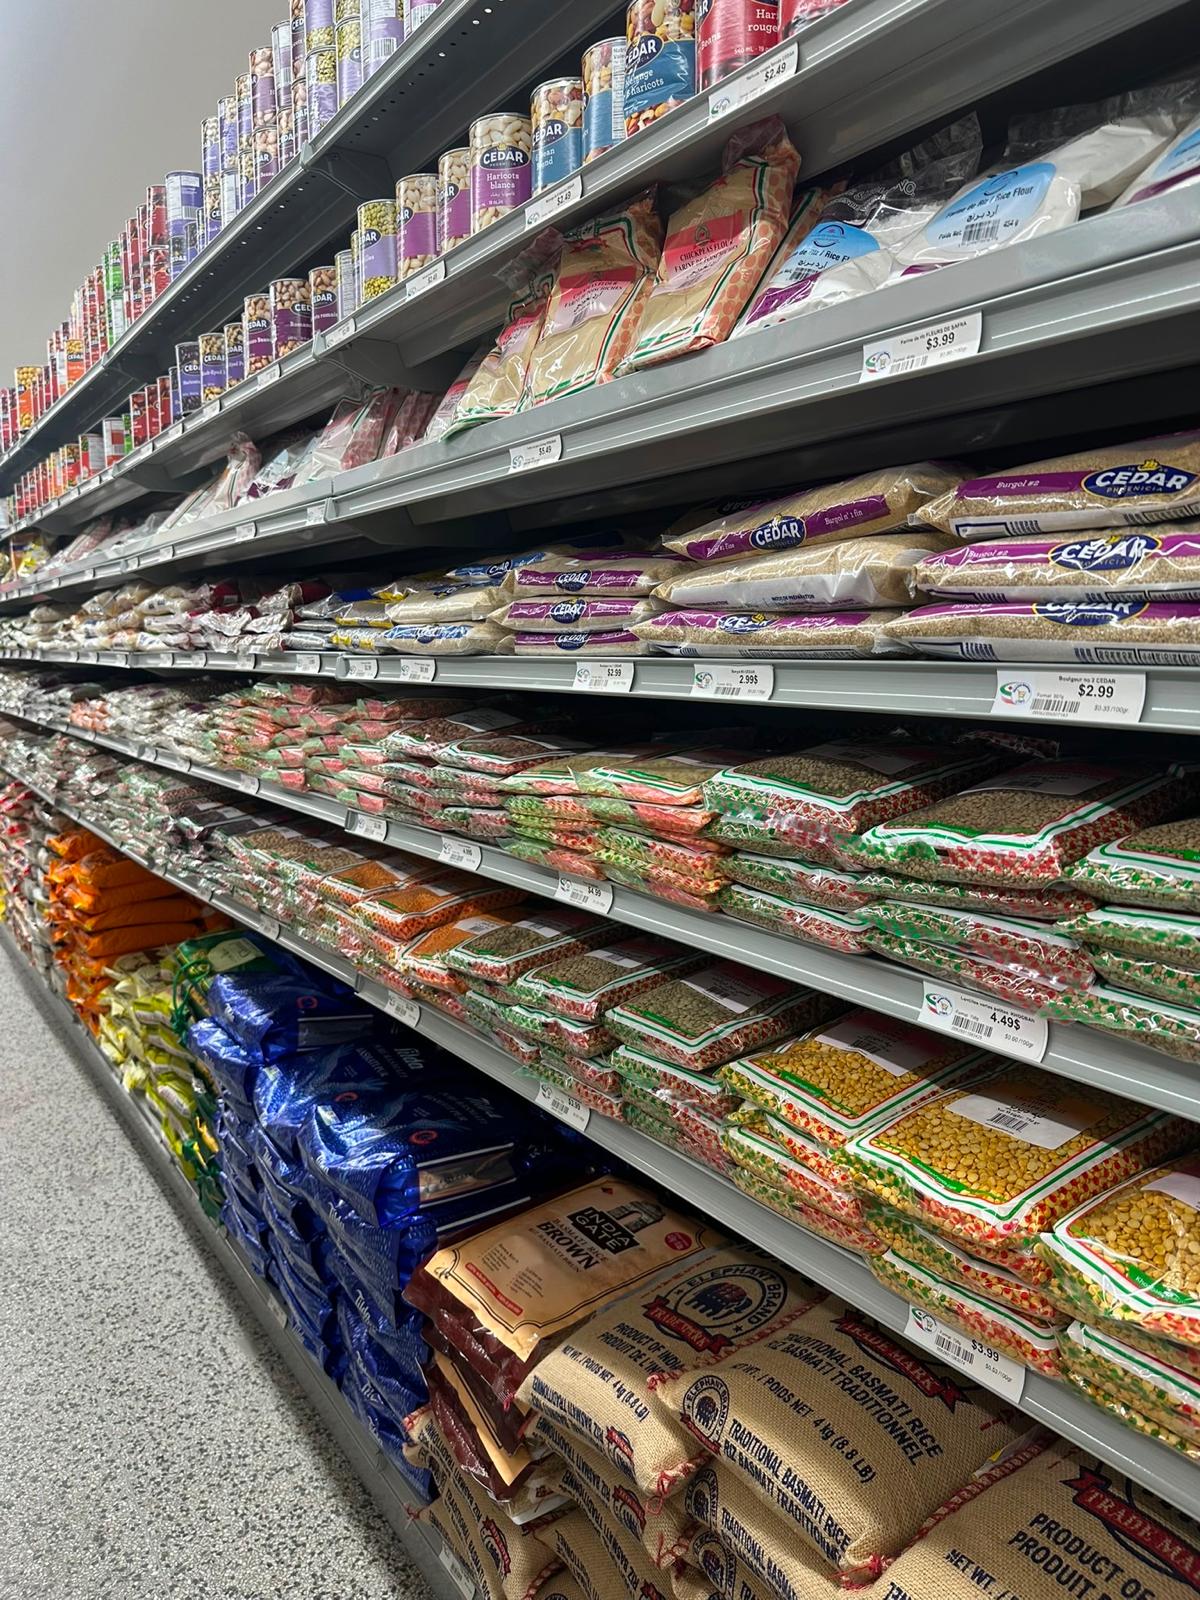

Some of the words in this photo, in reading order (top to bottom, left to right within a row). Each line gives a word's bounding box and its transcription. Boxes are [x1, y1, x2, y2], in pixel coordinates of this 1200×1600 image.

[292, 17, 305, 30] CED
[764, 62, 787, 83] $2.49
[483, 150, 524, 164] CEDAR
[487, 172, 520, 181] Haricots
[490, 181, 516, 190] blancs
[1012, 186, 1034, 197] Flour
[360, 232, 377, 242] DAR
[314, 293, 333, 303] EDAR
[248, 320, 267, 329] EDAR
[926, 332, 955, 351] $3.99
[996, 481, 1026, 489] Burgol
[1026, 480, 1040, 488] #2
[1095, 471, 1188, 490] CEDAR
[755, 522, 801, 546] CEDAR
[1061, 541, 1146, 560] CEDAR
[607, 668, 622, 677] $2.99
[739, 675, 759, 685] 2.99$
[1078, 684, 1114, 698] $2.99
[990, 1012, 1021, 1031] 4.49$
[575, 1215, 619, 1250] GATE
[584, 1209, 630, 1246] INDIA
[536, 1222, 601, 1271] BROWN
[687, 1266, 776, 1287] ELEPHANT
[747, 1284, 781, 1325] BRAND
[597, 1331, 636, 1354] PRODUIT
[629, 1350, 647, 1362] DE
[613, 1322, 655, 1346] PRODUCT
[648, 1341, 666, 1352] OF
[971, 1339, 1000, 1362] $3.99
[583, 1357, 604, 1375] POIDS
[600, 1368, 616, 1383] NET
[612, 1380, 622, 1389] 4
[687, 1378, 723, 1402] ELEPHANT
[782, 1344, 837, 1376] BASMATI
[833, 1371, 925, 1465] TRADITIONNEL
[849, 1365, 913, 1418] BASMATI
[906, 1417, 943, 1458] RICE
[763, 1376, 796, 1403] POIDS
[791, 1400, 814, 1418] NET
[812, 1418, 826, 1429] 4
[819, 1423, 836, 1440] kg
[830, 1434, 859, 1461] (8.8
[851, 1458, 877, 1486] LB)
[729, 1419, 783, 1480] TRADITIONAL
[782, 1467, 826, 1524] BASMATI
[824, 1514, 851, 1553] RICE
[738, 1452, 775, 1498] BASMATI
[1030, 1513, 1124, 1580] PRODUCT
[1088, 1490, 1152, 1540] TRADE
[1158, 1538, 1200, 1580] MA
[946, 1549, 975, 1573] NET
[1008, 1530, 1097, 1600] PRODUIT
